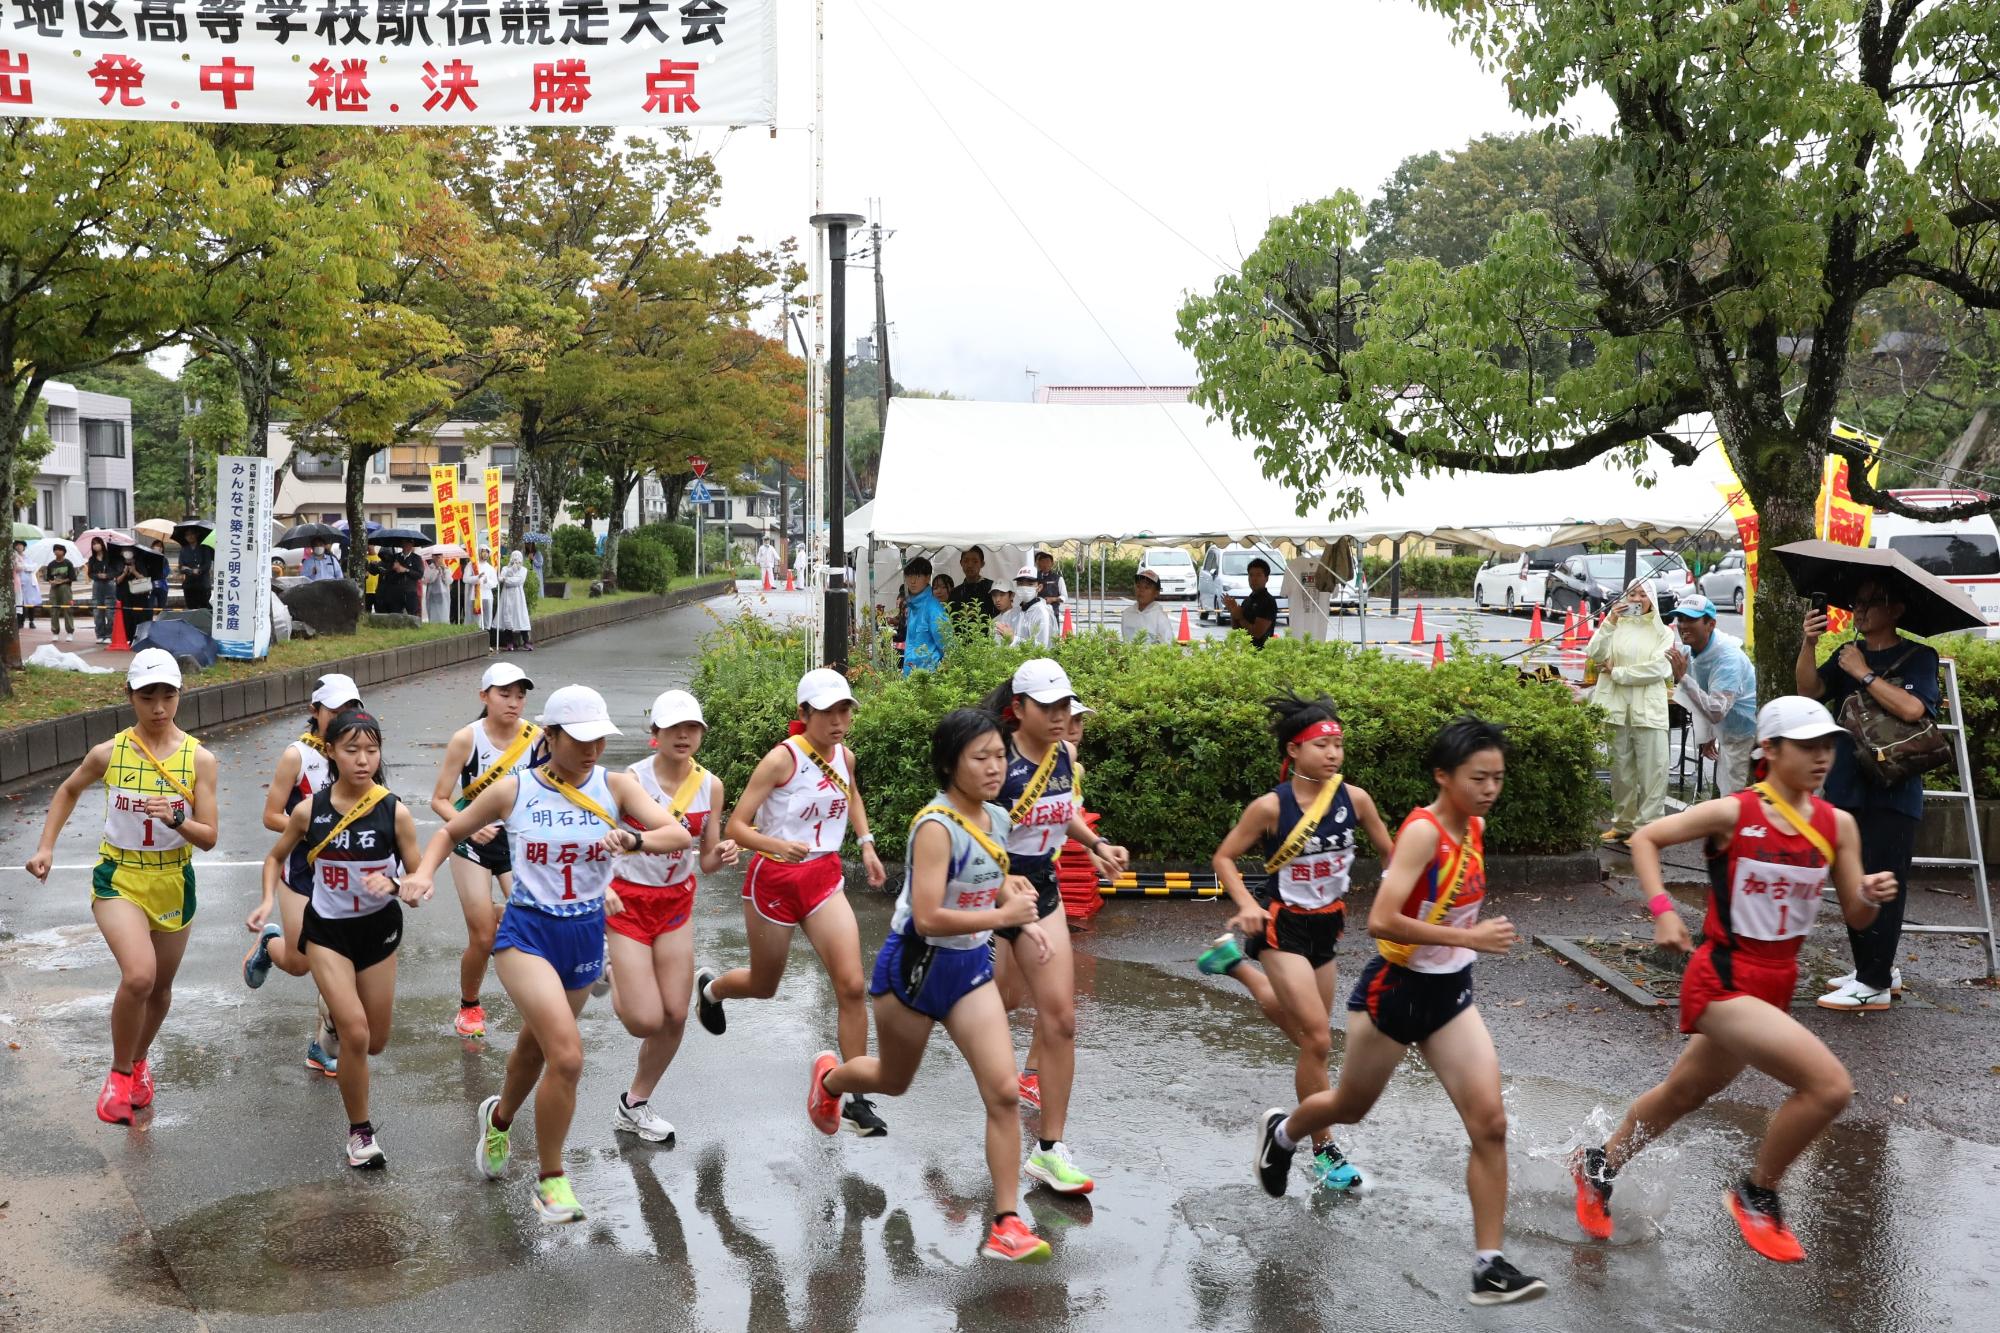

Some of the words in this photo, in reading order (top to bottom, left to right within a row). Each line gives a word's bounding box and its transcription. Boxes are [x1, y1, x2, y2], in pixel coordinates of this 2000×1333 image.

[0, 0, 729, 46] 地区高等学校駅伝競走大会
[435, 469, 452, 478] 兵庫
[226, 463, 245, 631] みんなで築こう明るい家庭
[115, 794, 185, 815] 加古西
[800, 798, 847, 821] 小野
[532, 809, 600, 827] 明石北
[142, 819, 154, 847] 1
[330, 830, 377, 849] 明石
[814, 820, 823, 847] 1
[1039, 829, 1050, 852] 1
[526, 842, 607, 865] 明石北
[561, 864, 577, 900] 1
[664, 863, 679, 884] 1
[1776, 904, 1789, 936] 1
